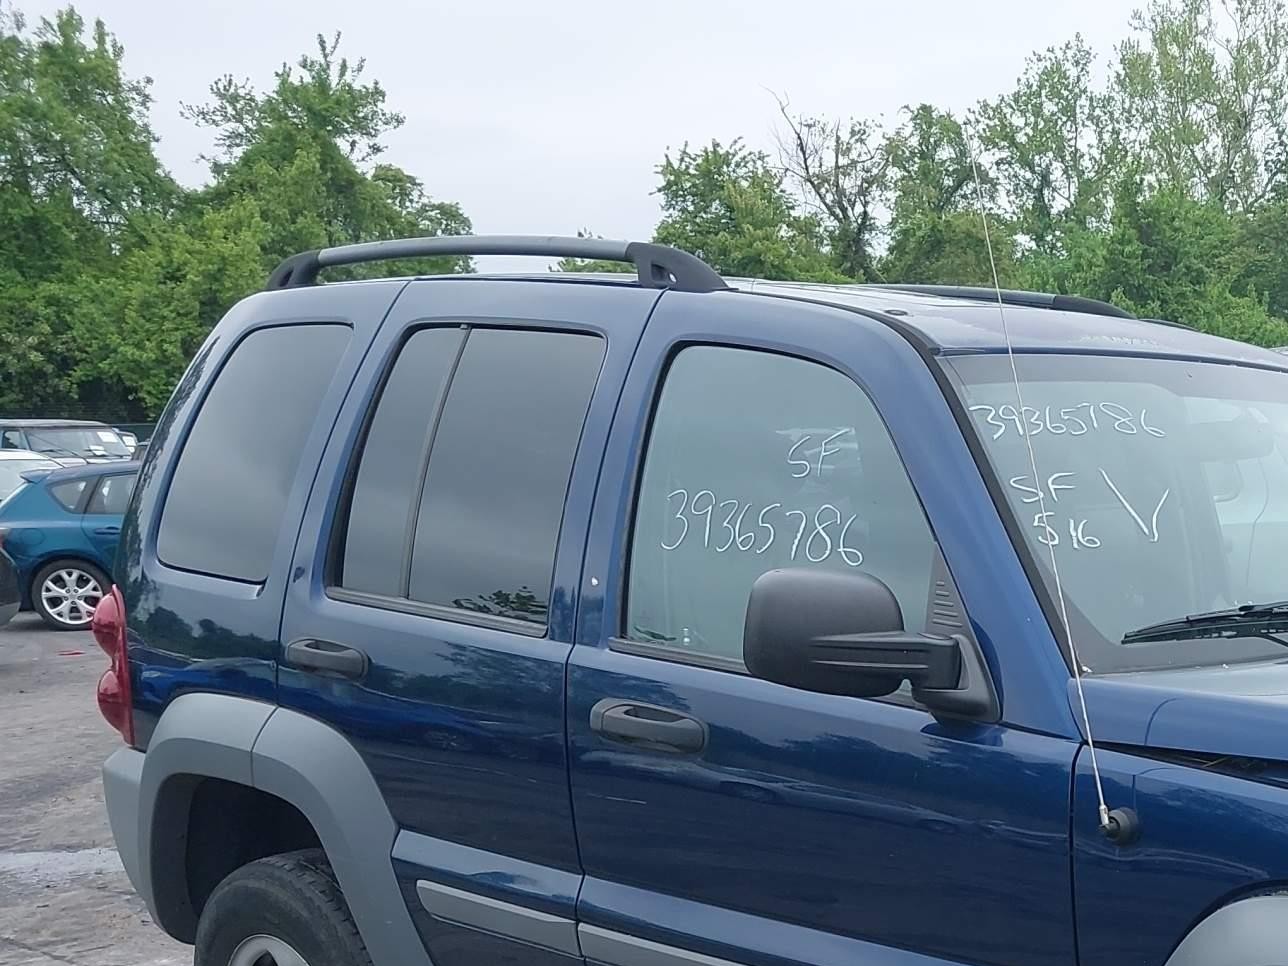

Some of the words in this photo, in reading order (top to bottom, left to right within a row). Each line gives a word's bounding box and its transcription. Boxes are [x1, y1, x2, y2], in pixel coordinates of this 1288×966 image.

[968, 402, 1166, 440] 39365786
[787, 428, 850, 478] SF
[1009, 472, 1076, 503] SF
[661, 489, 863, 566] 39365786
